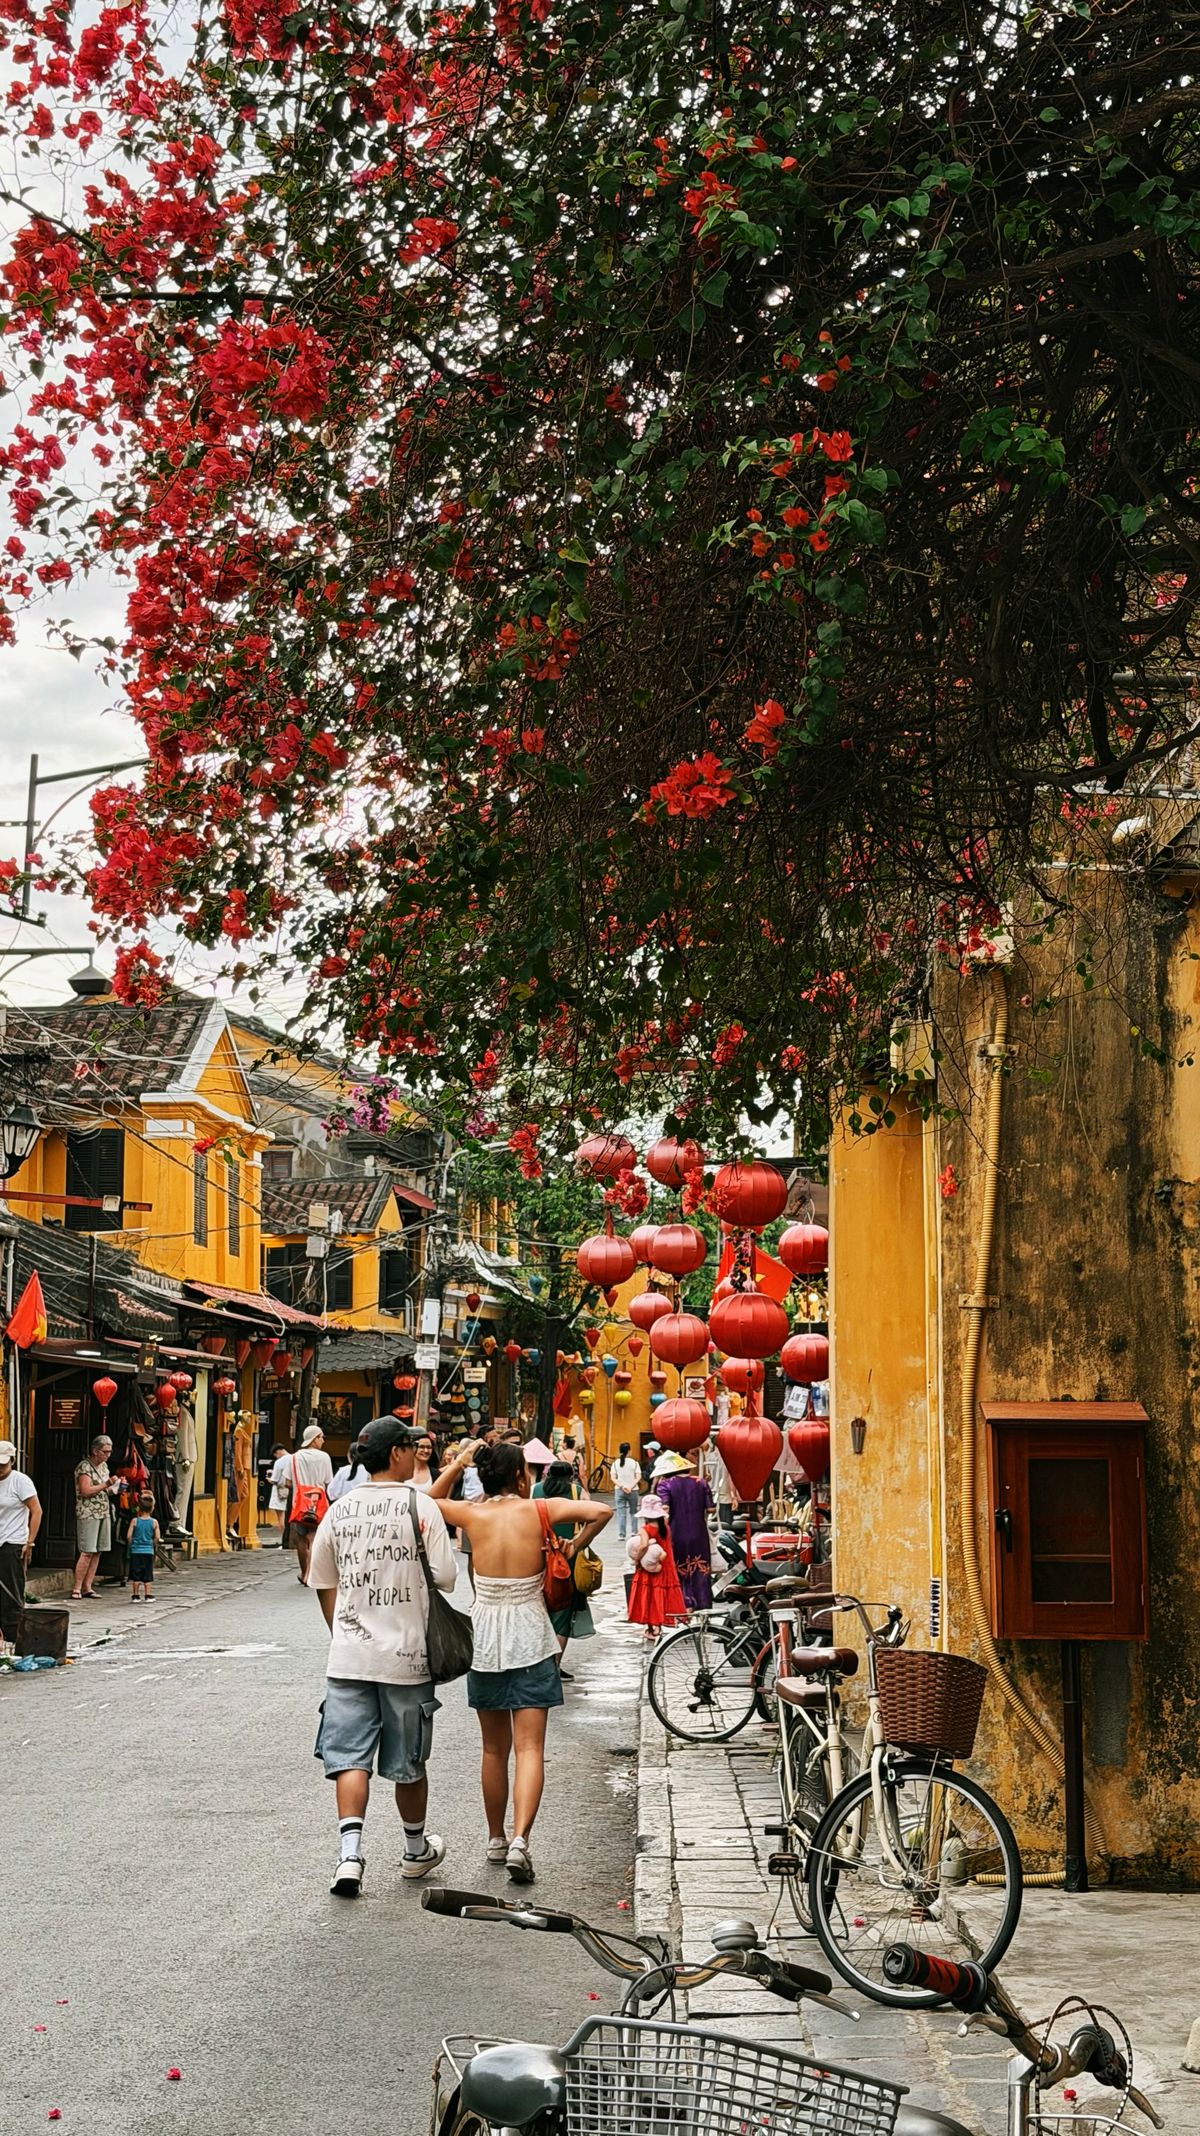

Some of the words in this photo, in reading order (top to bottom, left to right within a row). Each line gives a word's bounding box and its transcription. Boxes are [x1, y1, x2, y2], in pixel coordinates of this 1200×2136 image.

[366, 1499, 393, 1517] WAIT
[365, 1522, 387, 1539] TIME
[365, 1545, 419, 1562] MEMORIE
[369, 1587, 412, 1606] PEOPLE
